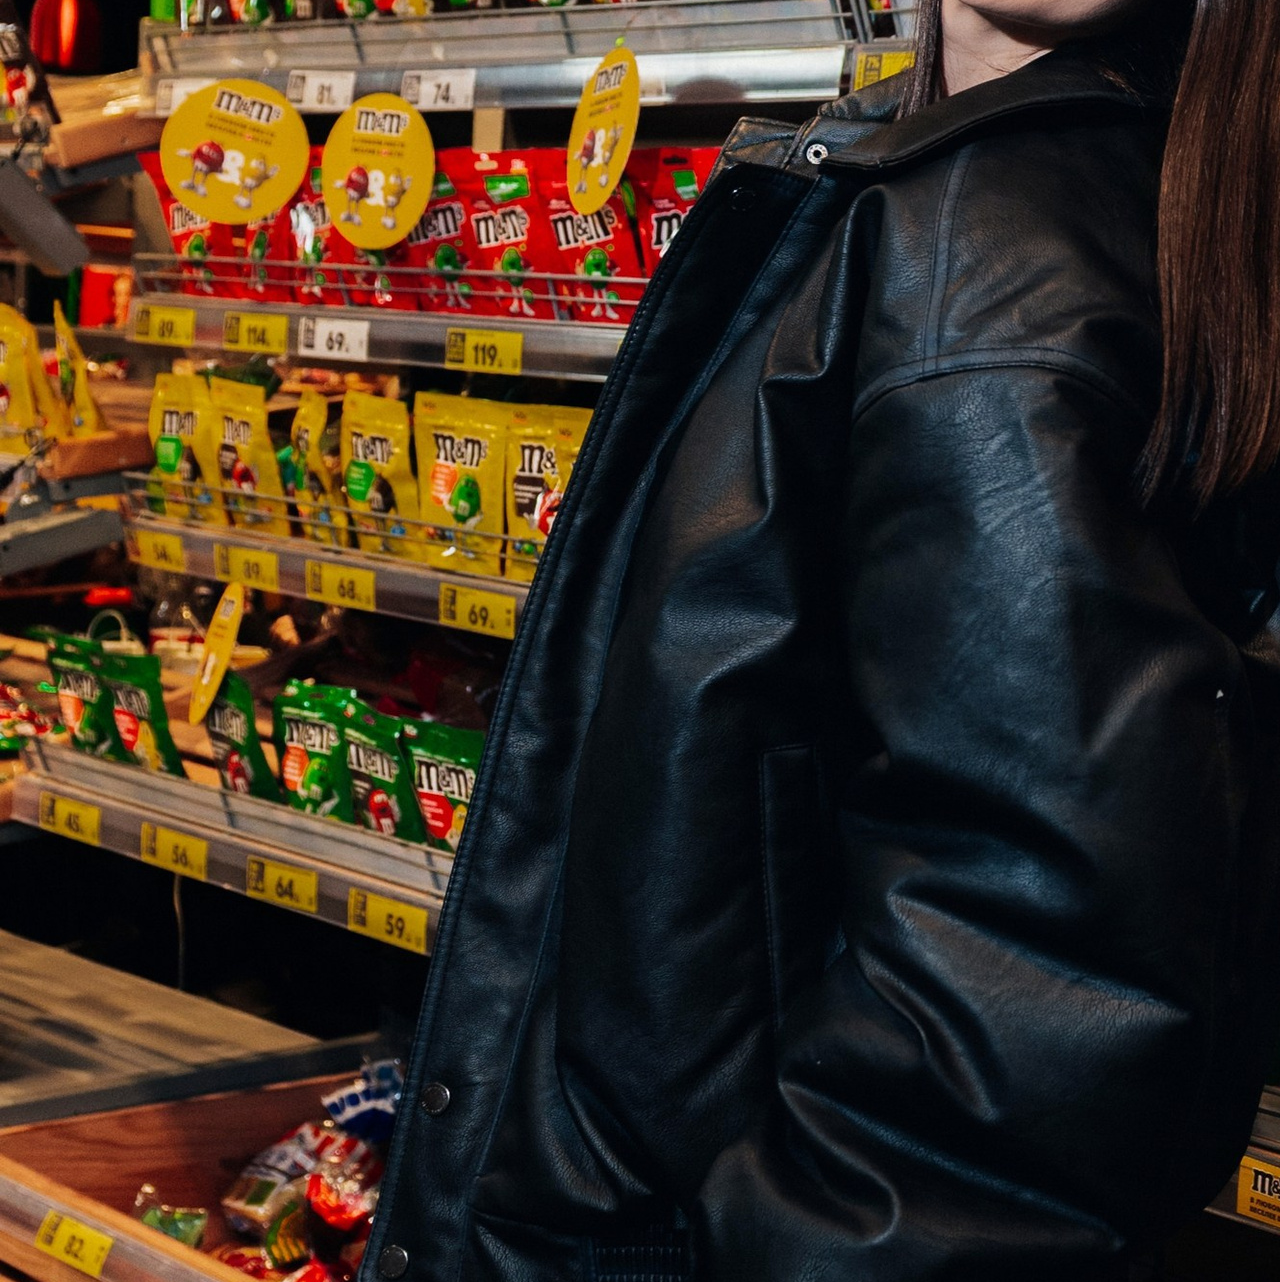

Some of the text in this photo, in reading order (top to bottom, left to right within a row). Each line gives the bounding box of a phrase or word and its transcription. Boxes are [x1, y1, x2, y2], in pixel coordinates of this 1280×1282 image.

[326, 332, 344, 352] 69
[473, 344, 497, 365] 119
[468, 606, 489, 627] 69
[171, 845, 189, 868] 56
[274, 877, 294, 900] 64
[384, 916, 406, 939] 59
